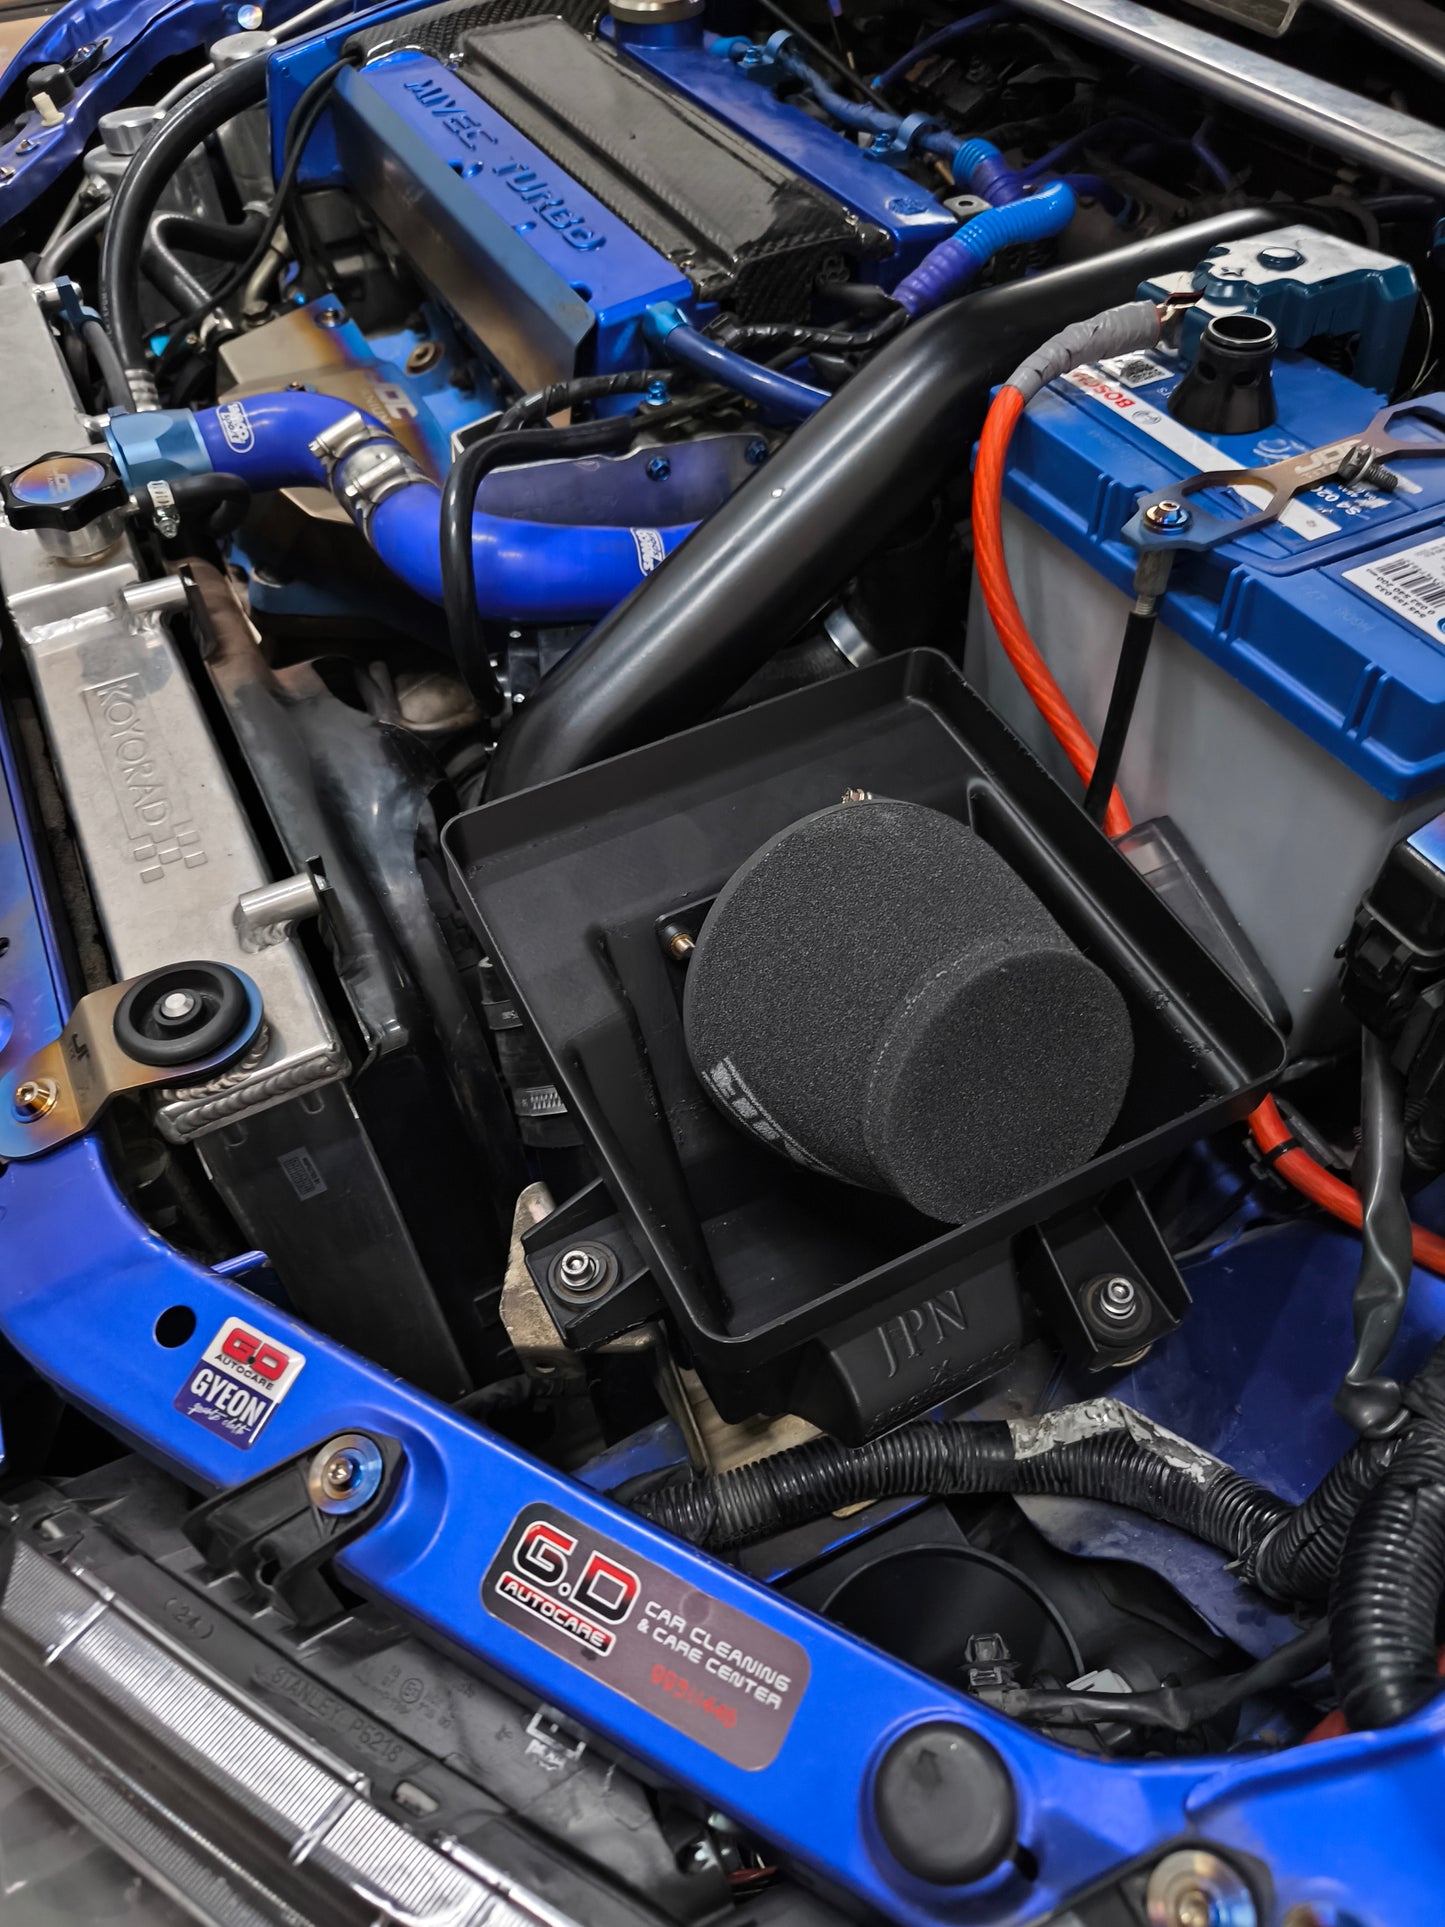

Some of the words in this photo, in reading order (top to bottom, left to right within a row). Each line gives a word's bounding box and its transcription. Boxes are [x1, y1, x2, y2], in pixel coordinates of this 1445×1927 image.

[404, 79, 498, 152] MIVEC
[492, 156, 607, 252] TURBO
[97, 682, 172, 826] KOYORAD
[214, 1353, 274, 1391] AUTOCARE
[876, 1289, 967, 1378] JPN
[190, 1368, 266, 1427] GYEON
[503, 1580, 607, 1648] AUTOCARE
[644, 1600, 687, 1634] CAR
[689, 1626, 791, 1693] CLEANING
[269, 1666, 351, 1723] STANLEY
[636, 1617, 648, 1634] &
[652, 1626, 703, 1664] CARE
[705, 1657, 783, 1710] CENTER
